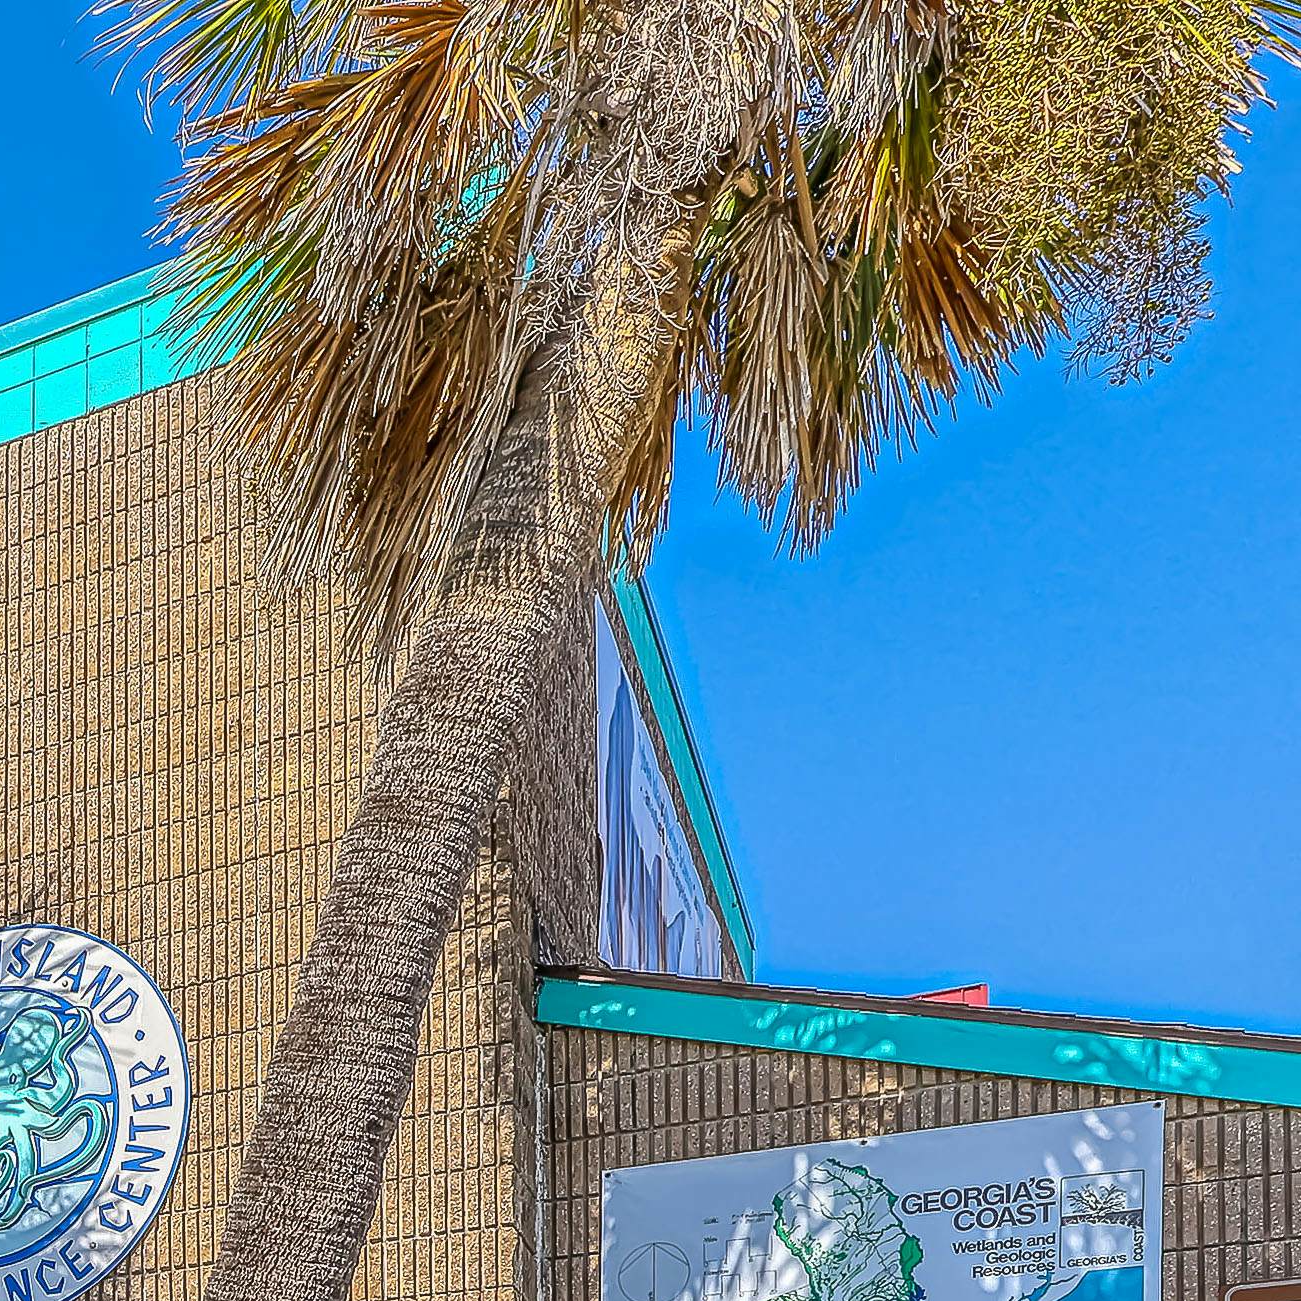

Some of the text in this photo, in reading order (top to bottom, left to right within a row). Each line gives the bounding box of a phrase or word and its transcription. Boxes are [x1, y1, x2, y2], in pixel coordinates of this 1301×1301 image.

[99, 1054, 174, 1234] CENTER
[901, 1176, 1056, 1215] GEORGIA'S
[953, 1202, 1056, 1232] COAST
[952, 1233, 1056, 1254] Wetlands and
[1133, 1229, 1145, 1261] COAST
[986, 1248, 1056, 1265] Geologic
[1067, 1254, 1127, 1267] GEORGIA'S
[972, 1261, 1056, 1278] Resources
